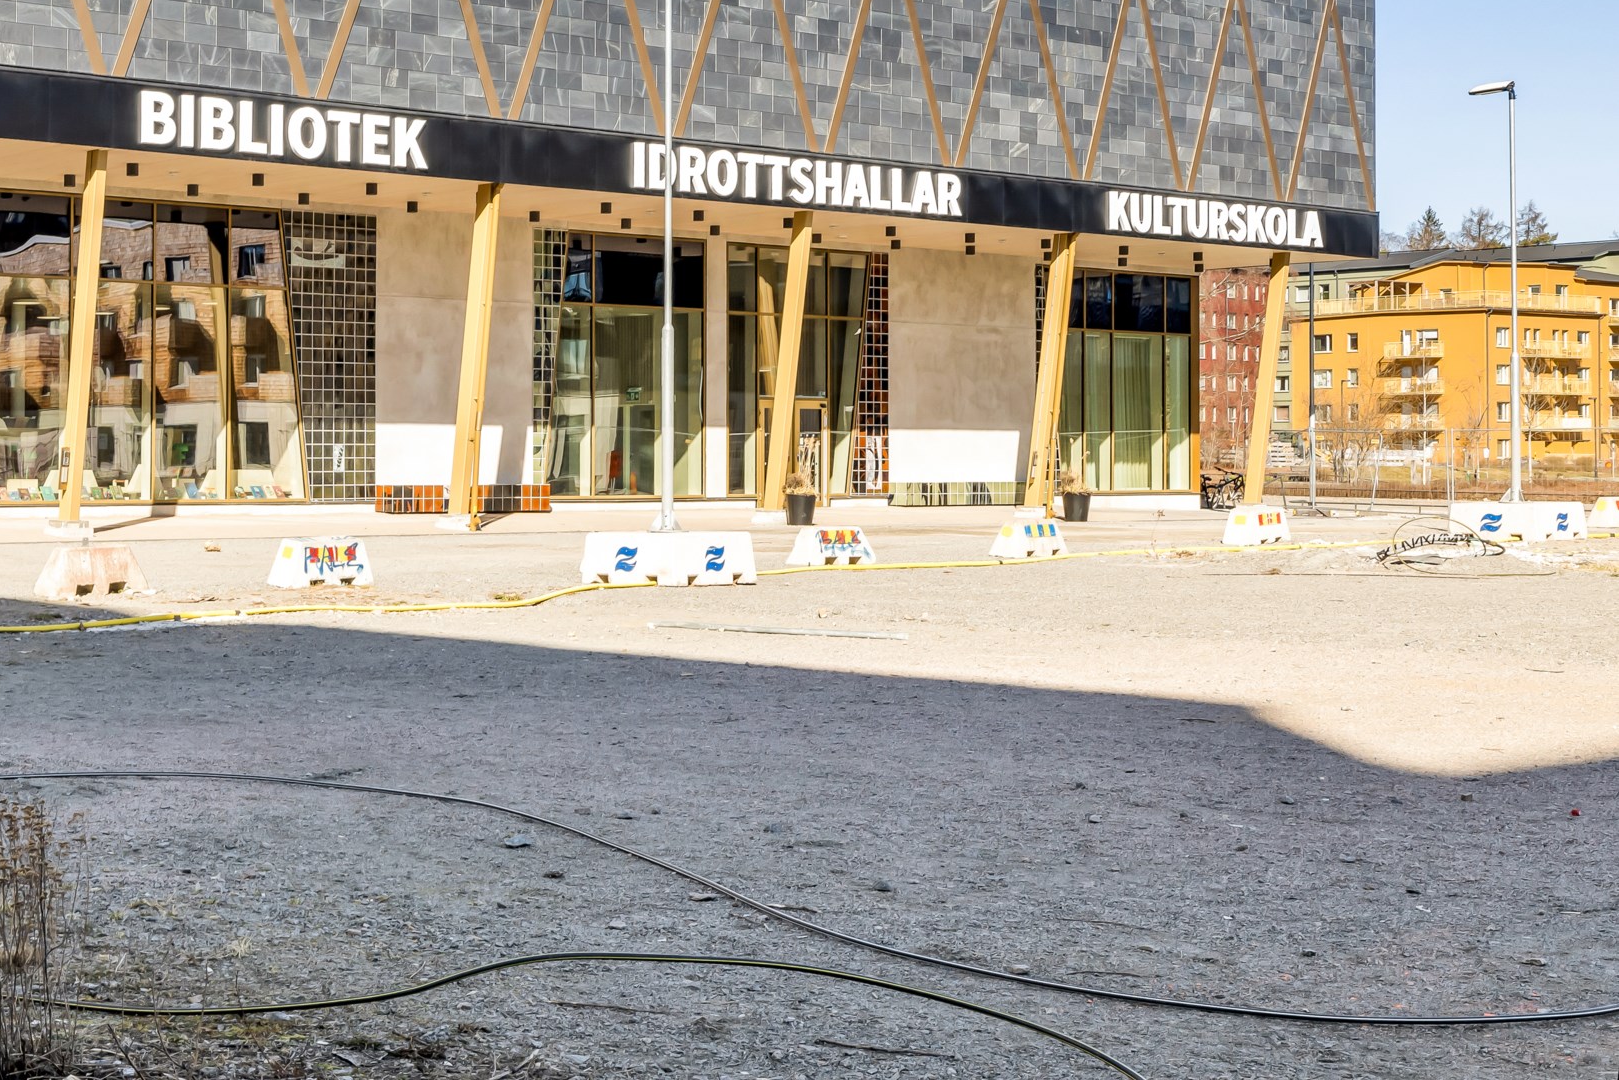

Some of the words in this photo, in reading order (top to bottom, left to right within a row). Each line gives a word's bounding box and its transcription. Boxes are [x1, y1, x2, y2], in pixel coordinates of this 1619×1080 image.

[139, 90, 429, 170] BIBLIOTEK
[632, 141, 963, 216] IDROTTSHALLAR
[1108, 190, 1324, 248] KULTURSKOLA
